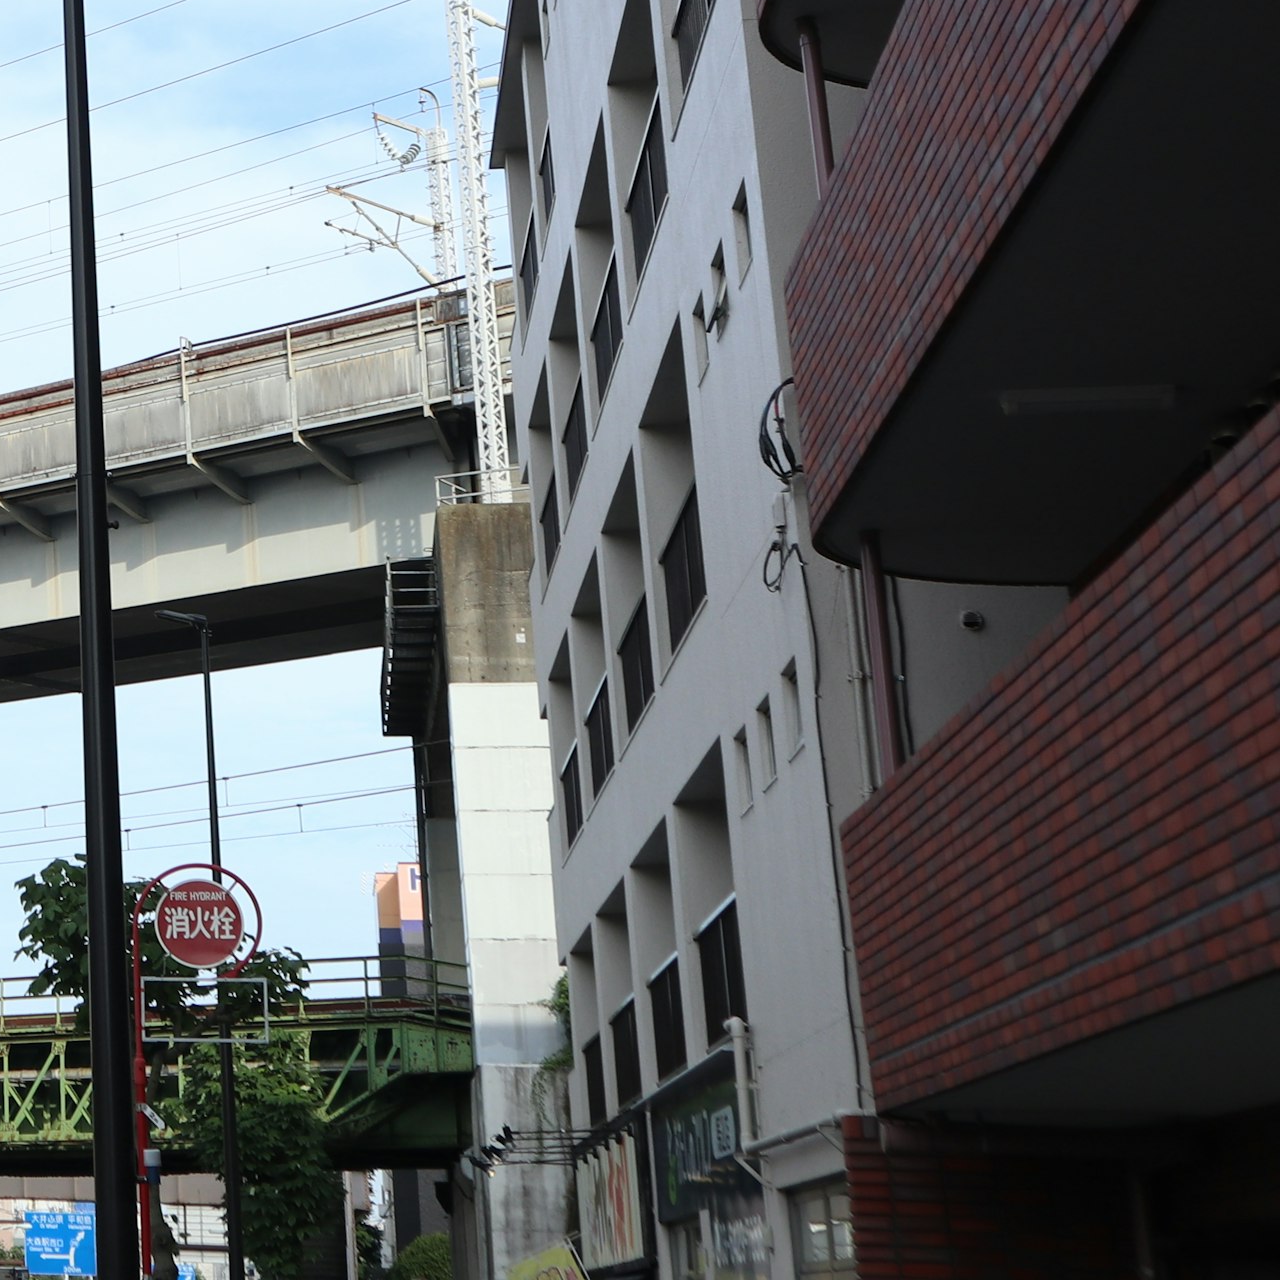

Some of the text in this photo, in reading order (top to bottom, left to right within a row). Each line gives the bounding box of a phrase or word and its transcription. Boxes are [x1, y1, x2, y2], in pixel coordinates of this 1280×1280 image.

[169, 891, 227, 901] FIRE HYDRANT
[164, 906, 236, 940] 消火栓
